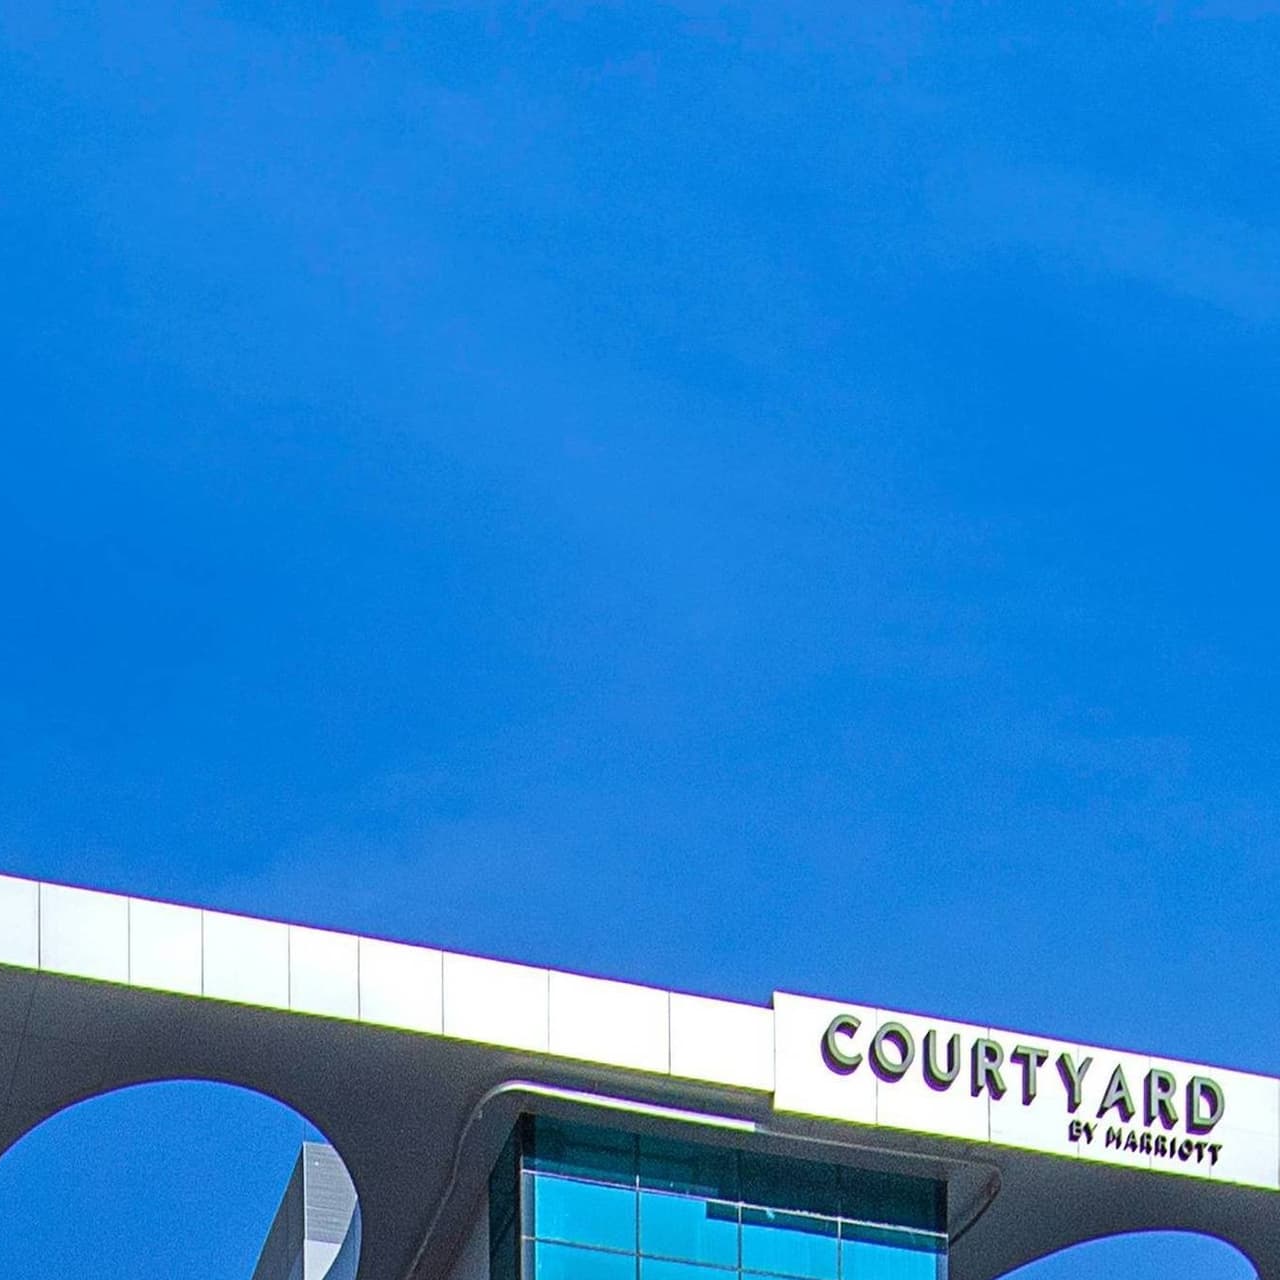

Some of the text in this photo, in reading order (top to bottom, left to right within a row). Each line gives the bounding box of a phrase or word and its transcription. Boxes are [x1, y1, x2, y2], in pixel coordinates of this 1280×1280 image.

[820, 1013, 1226, 1136] COURTYARD
[1068, 1119, 1223, 1166] BY MARRIOTT
